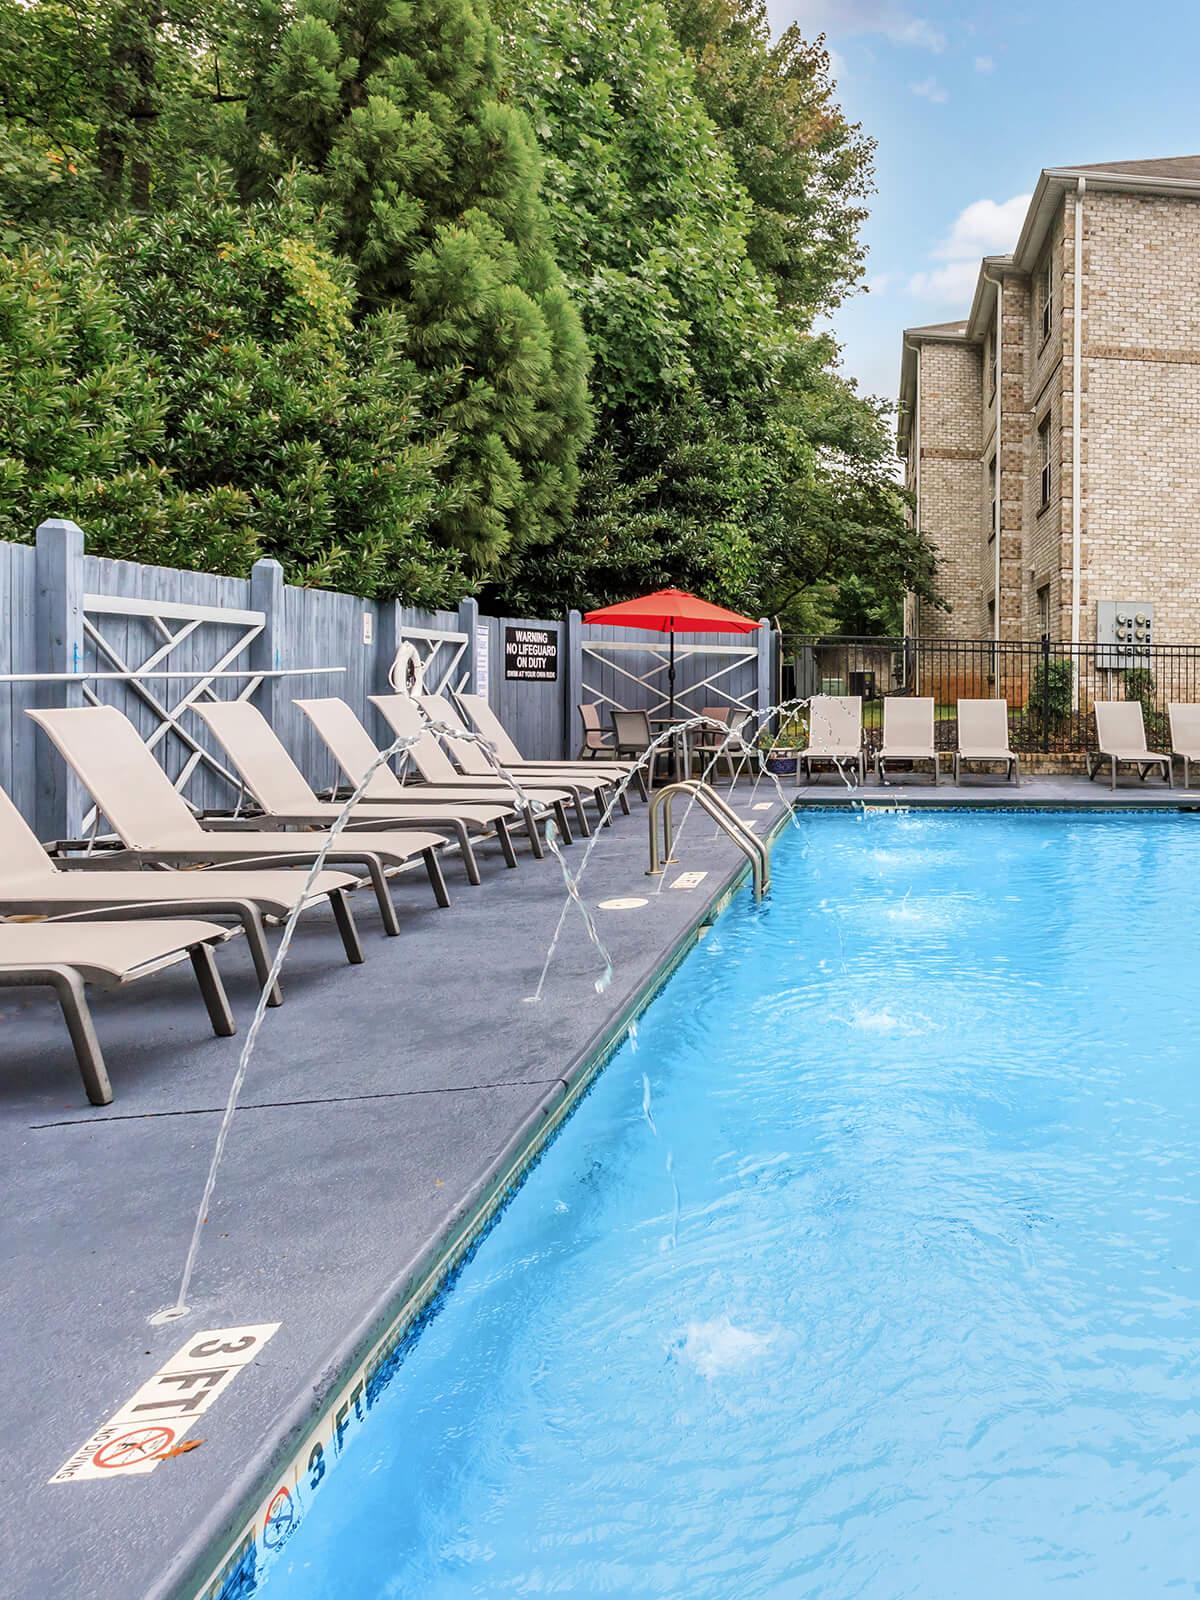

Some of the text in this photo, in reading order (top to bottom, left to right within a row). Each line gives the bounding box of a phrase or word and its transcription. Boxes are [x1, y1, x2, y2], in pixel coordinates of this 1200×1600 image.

[506, 642, 557, 657] NO LIFEGUARD
[515, 630, 548, 643] WARNING
[516, 656, 547, 669] ON DUTY
[130, 1335, 257, 1413] 3 FT
[55, 1427, 119, 1480] NO DIVING
[307, 1441, 326, 1490] 3
